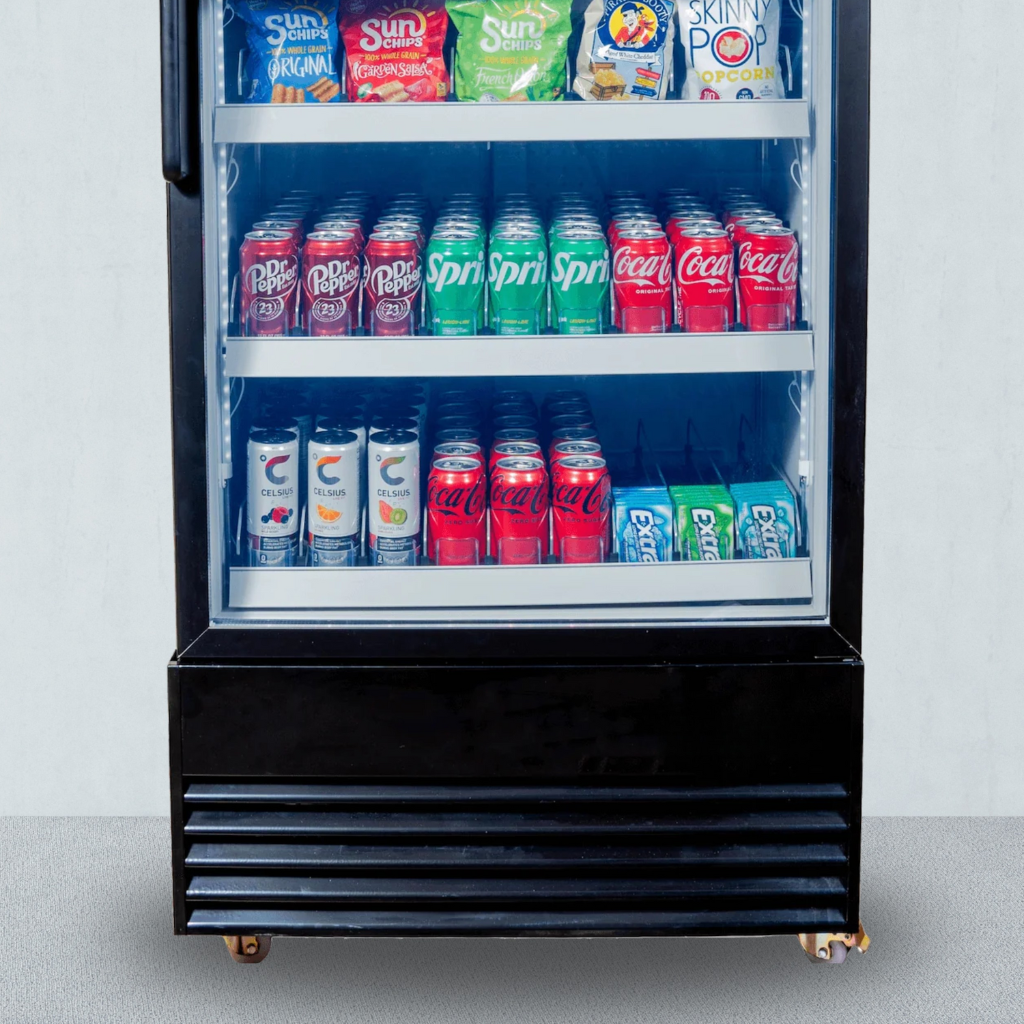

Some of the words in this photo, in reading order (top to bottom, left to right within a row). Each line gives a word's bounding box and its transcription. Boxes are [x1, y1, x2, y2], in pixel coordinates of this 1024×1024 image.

[265, 12, 328, 46] Sun
[287, 28, 329, 41] CHIPS
[359, 18, 427, 52] Sun
[480, 14, 546, 53] Sun
[287, 46, 307, 55] WHOLE
[308, 45, 326, 54] GRAIN
[382, 36, 423, 49] CHIPS
[502, 40, 542, 51] CHIPS
[689, 24, 767, 68] POP
[267, 53, 337, 80] ORIGINAL
[381, 52, 400, 60] WHOLE
[401, 51, 420, 59] GRAIN
[265, 259, 289, 279] Dr
[327, 260, 350, 280] Dr
[392, 260, 414, 280] Dr
[426, 250, 484, 293] Spri
[551, 249, 609, 292] Spri
[613, 246, 672, 287] Coca-C
[247, 263, 297, 295] Pepper
[308, 264, 360, 296] Pepper
[372, 264, 422, 297] Pepper
[259, 302, 273, 315] 23
[321, 302, 335, 316] 23
[385, 302, 400, 316] 23
[261, 486, 294, 497] CELSIUS
[313, 487, 347, 497] CELSIUS
[377, 488, 411, 498] CELSIUS
[629, 509, 660, 562] Extra
[691, 508, 723, 561] Extra
[751, 505, 784, 559] Extra
